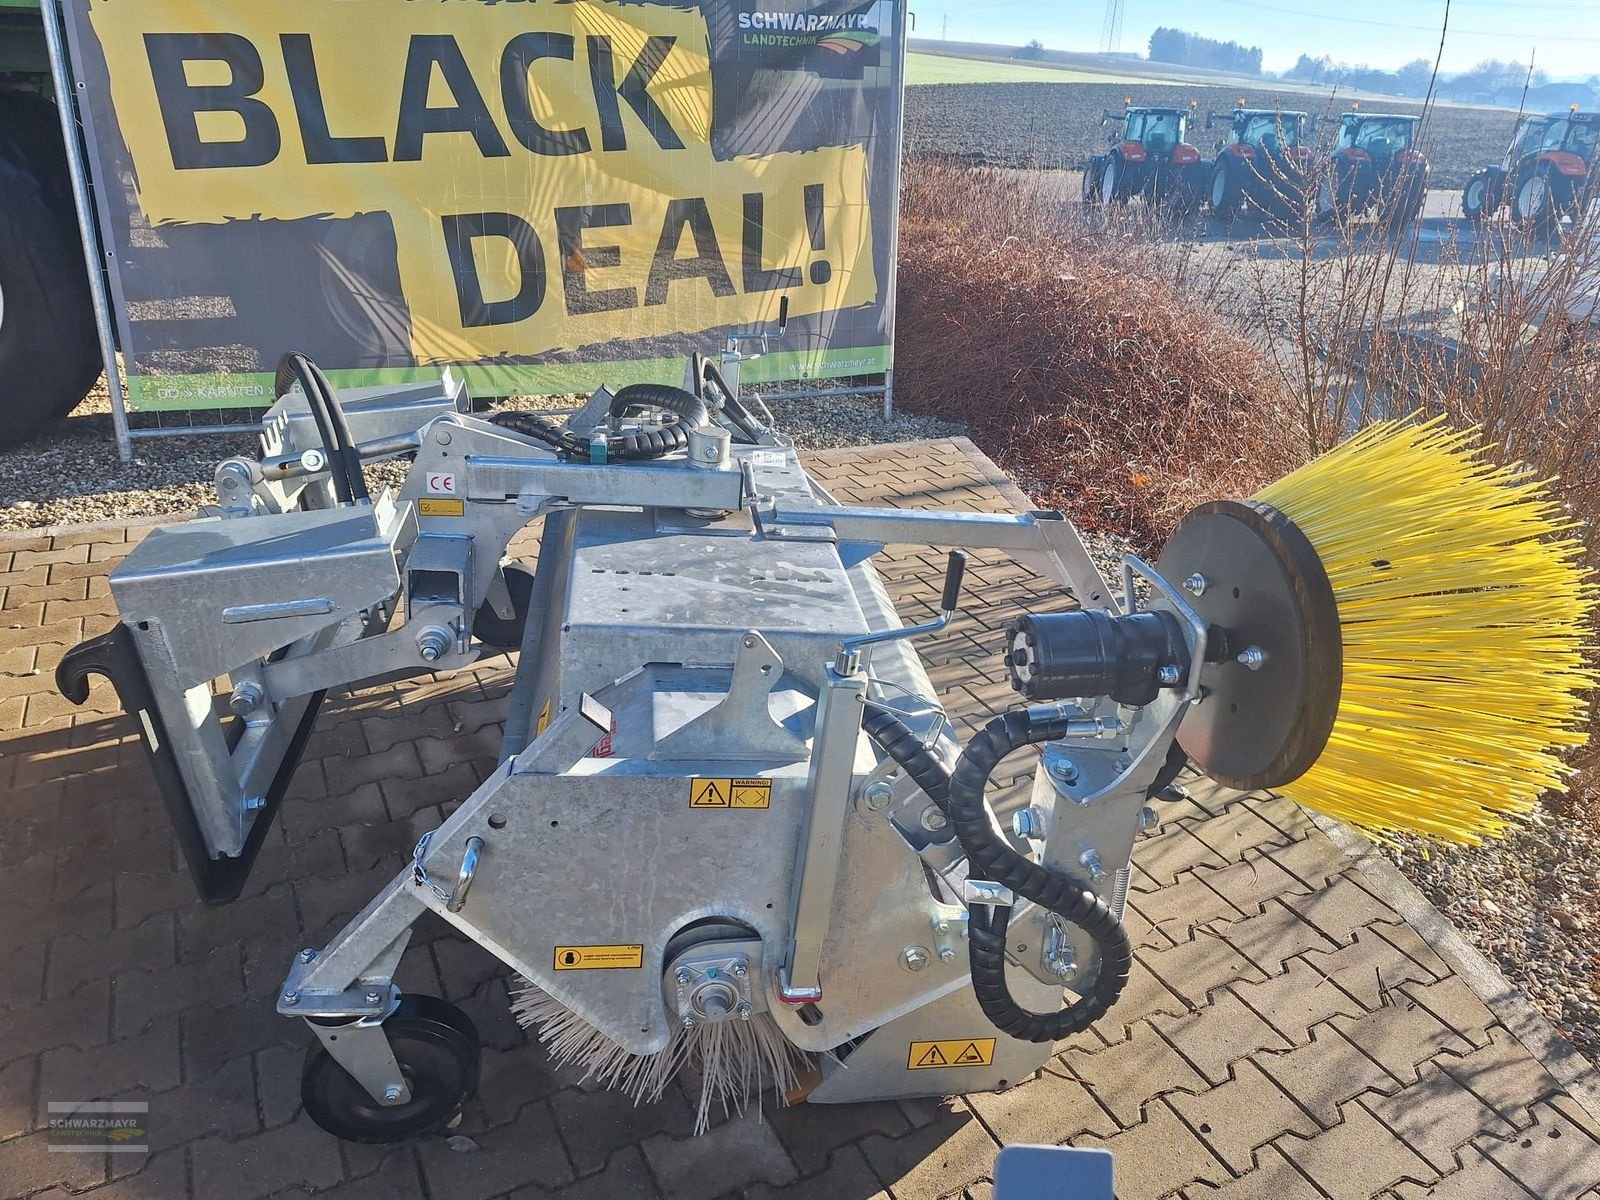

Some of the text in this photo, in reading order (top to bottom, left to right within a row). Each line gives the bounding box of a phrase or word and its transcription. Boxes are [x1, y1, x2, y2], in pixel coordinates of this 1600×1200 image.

[738, 12, 869, 31] SCHWARZMAYR
[744, 33, 818, 47] LANDTECHNIK
[142, 32, 686, 171] BLACK
[441, 183, 832, 328] DEAL!
[789, 357, 875, 371] www.schwarzmayr.at
[430, 476, 452, 491] CE
